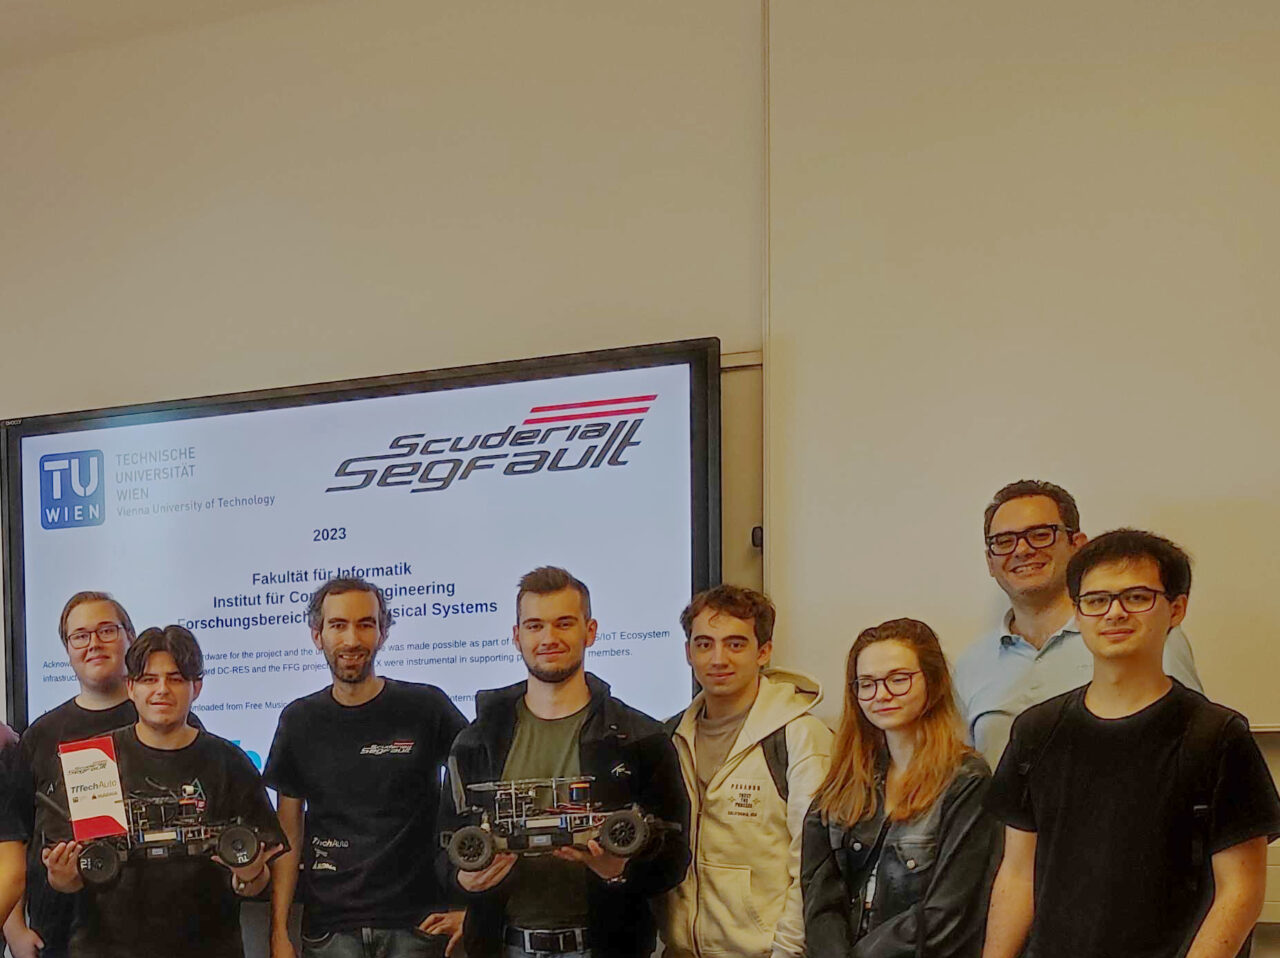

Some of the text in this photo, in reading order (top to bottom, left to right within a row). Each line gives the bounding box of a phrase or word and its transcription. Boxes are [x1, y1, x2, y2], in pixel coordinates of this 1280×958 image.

[389, 423, 611, 455] Scuderia
[116, 447, 196, 467] TECHNISCHE
[43, 456, 99, 500] TU
[116, 464, 196, 484] UNIVERSITÄT
[117, 488, 149, 502] WIEN
[46, 503, 100, 523] WIEN
[117, 494, 276, 517] Vienna University of Technology
[312, 527, 347, 542] 2023
[252, 562, 412, 586] Fakultät für Informatik
[213, 592, 262, 609] Institut
[265, 590, 285, 606] für
[177, 611, 310, 631] Forschungsbereich
[432, 600, 498, 618] Systems
[620, 630, 671, 641] Ecosystem
[389, 643, 405, 652] was
[407, 641, 430, 650] made
[432, 639, 467, 650] possible
[469, 640, 480, 648] as
[481, 638, 500, 648] part
[501, 637, 510, 646] of
[588, 648, 633, 657] members.
[229, 651, 240, 660] for
[241, 650, 254, 659] the
[255, 649, 283, 660] project
[284, 648, 299, 657] and
[300, 647, 313, 656] the
[384, 659, 404, 667] were
[406, 656, 457, 666] instrumental
[459, 655, 467, 664] in
[469, 653, 514, 665] supporting
[217, 665, 250, 676] DC-RES
[251, 665, 267, 674] and
[268, 664, 280, 673] the
[282, 663, 300, 672] FFG
[226, 702, 243, 711] from
[245, 701, 262, 710] Free
